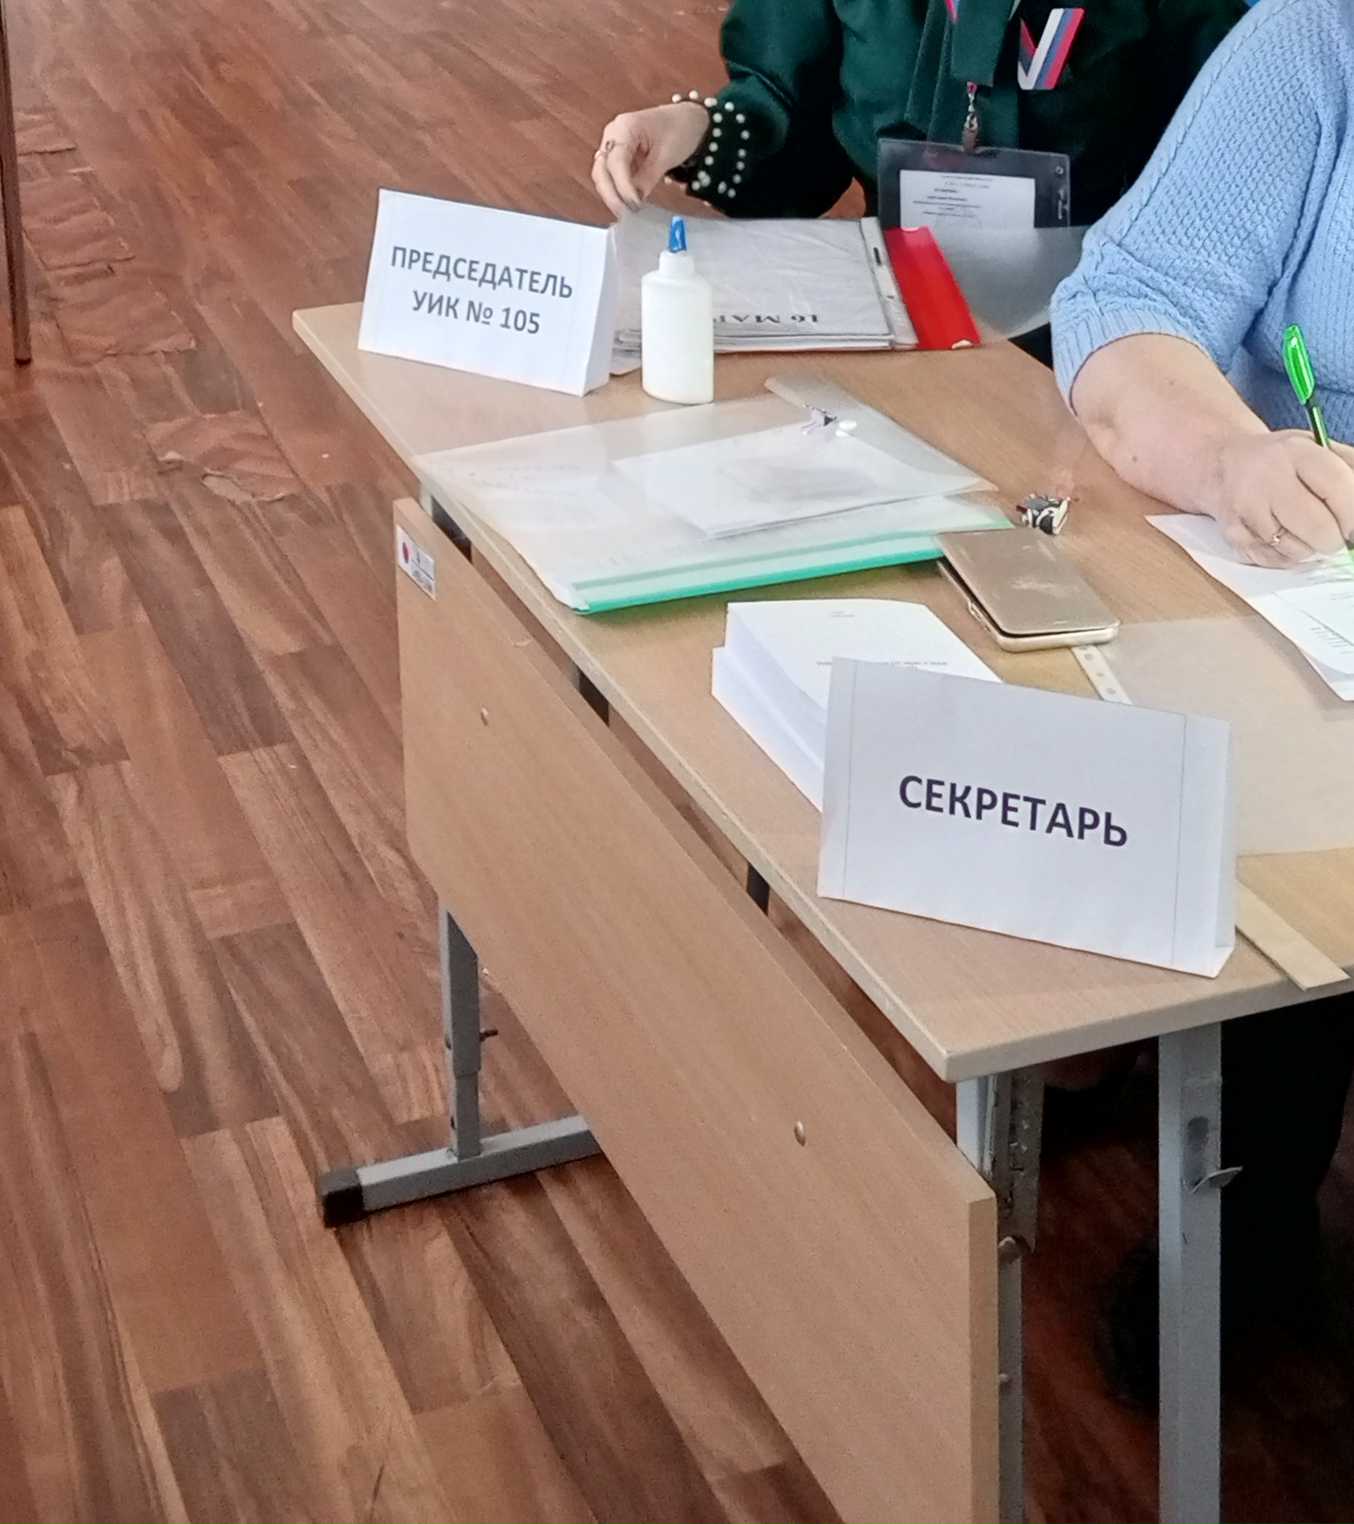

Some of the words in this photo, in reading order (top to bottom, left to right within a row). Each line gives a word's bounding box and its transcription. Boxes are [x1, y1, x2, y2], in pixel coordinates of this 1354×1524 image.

[391, 245, 573, 299] ПРЕДСЕДАТЕЛЬ
[412, 289, 460, 320] УИК
[466, 300, 493, 326] №
[499, 307, 541, 335] 105
[898, 774, 1129, 848] СЕКРЕТАРЬ
